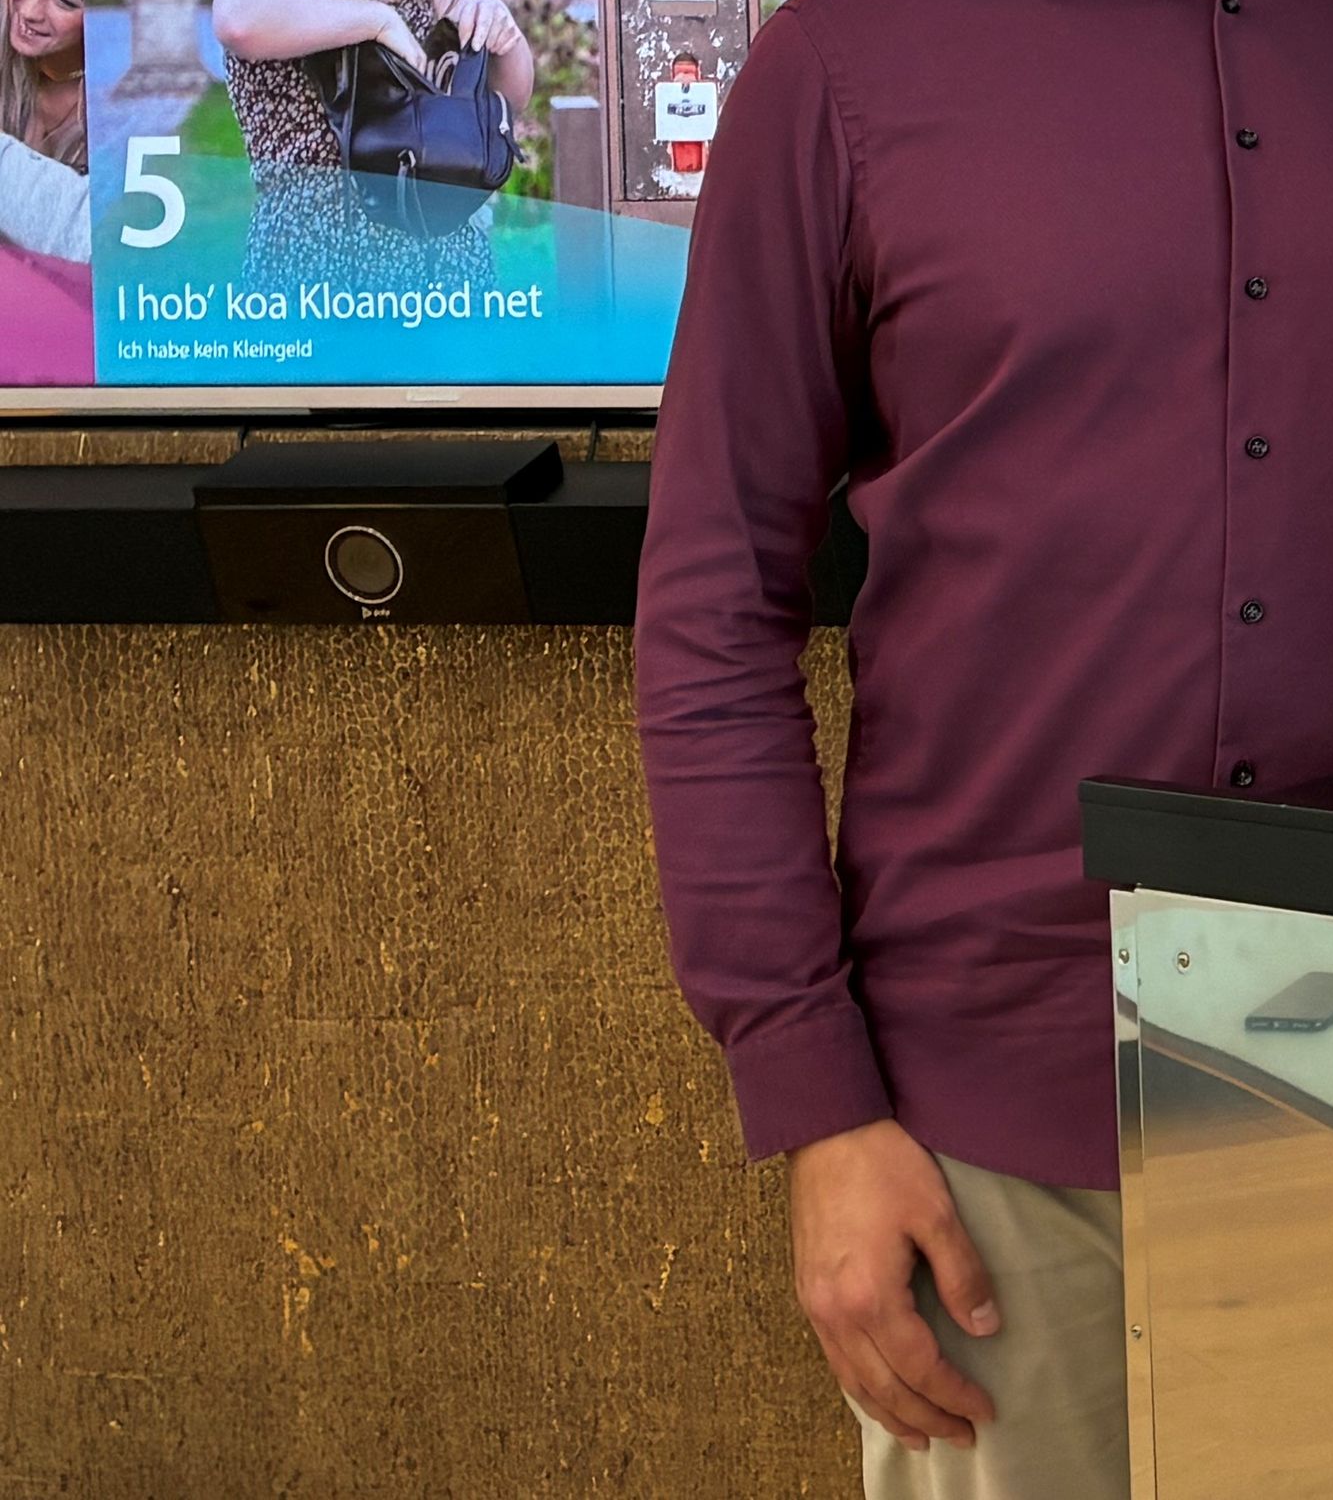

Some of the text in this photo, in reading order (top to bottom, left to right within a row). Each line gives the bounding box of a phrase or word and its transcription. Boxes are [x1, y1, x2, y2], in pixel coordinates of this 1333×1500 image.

[120, 135, 186, 249] 5
[118, 280, 543, 328] I hob' koa Kloangöd net
[118, 339, 313, 362] Ich habe kein Kleingeld
